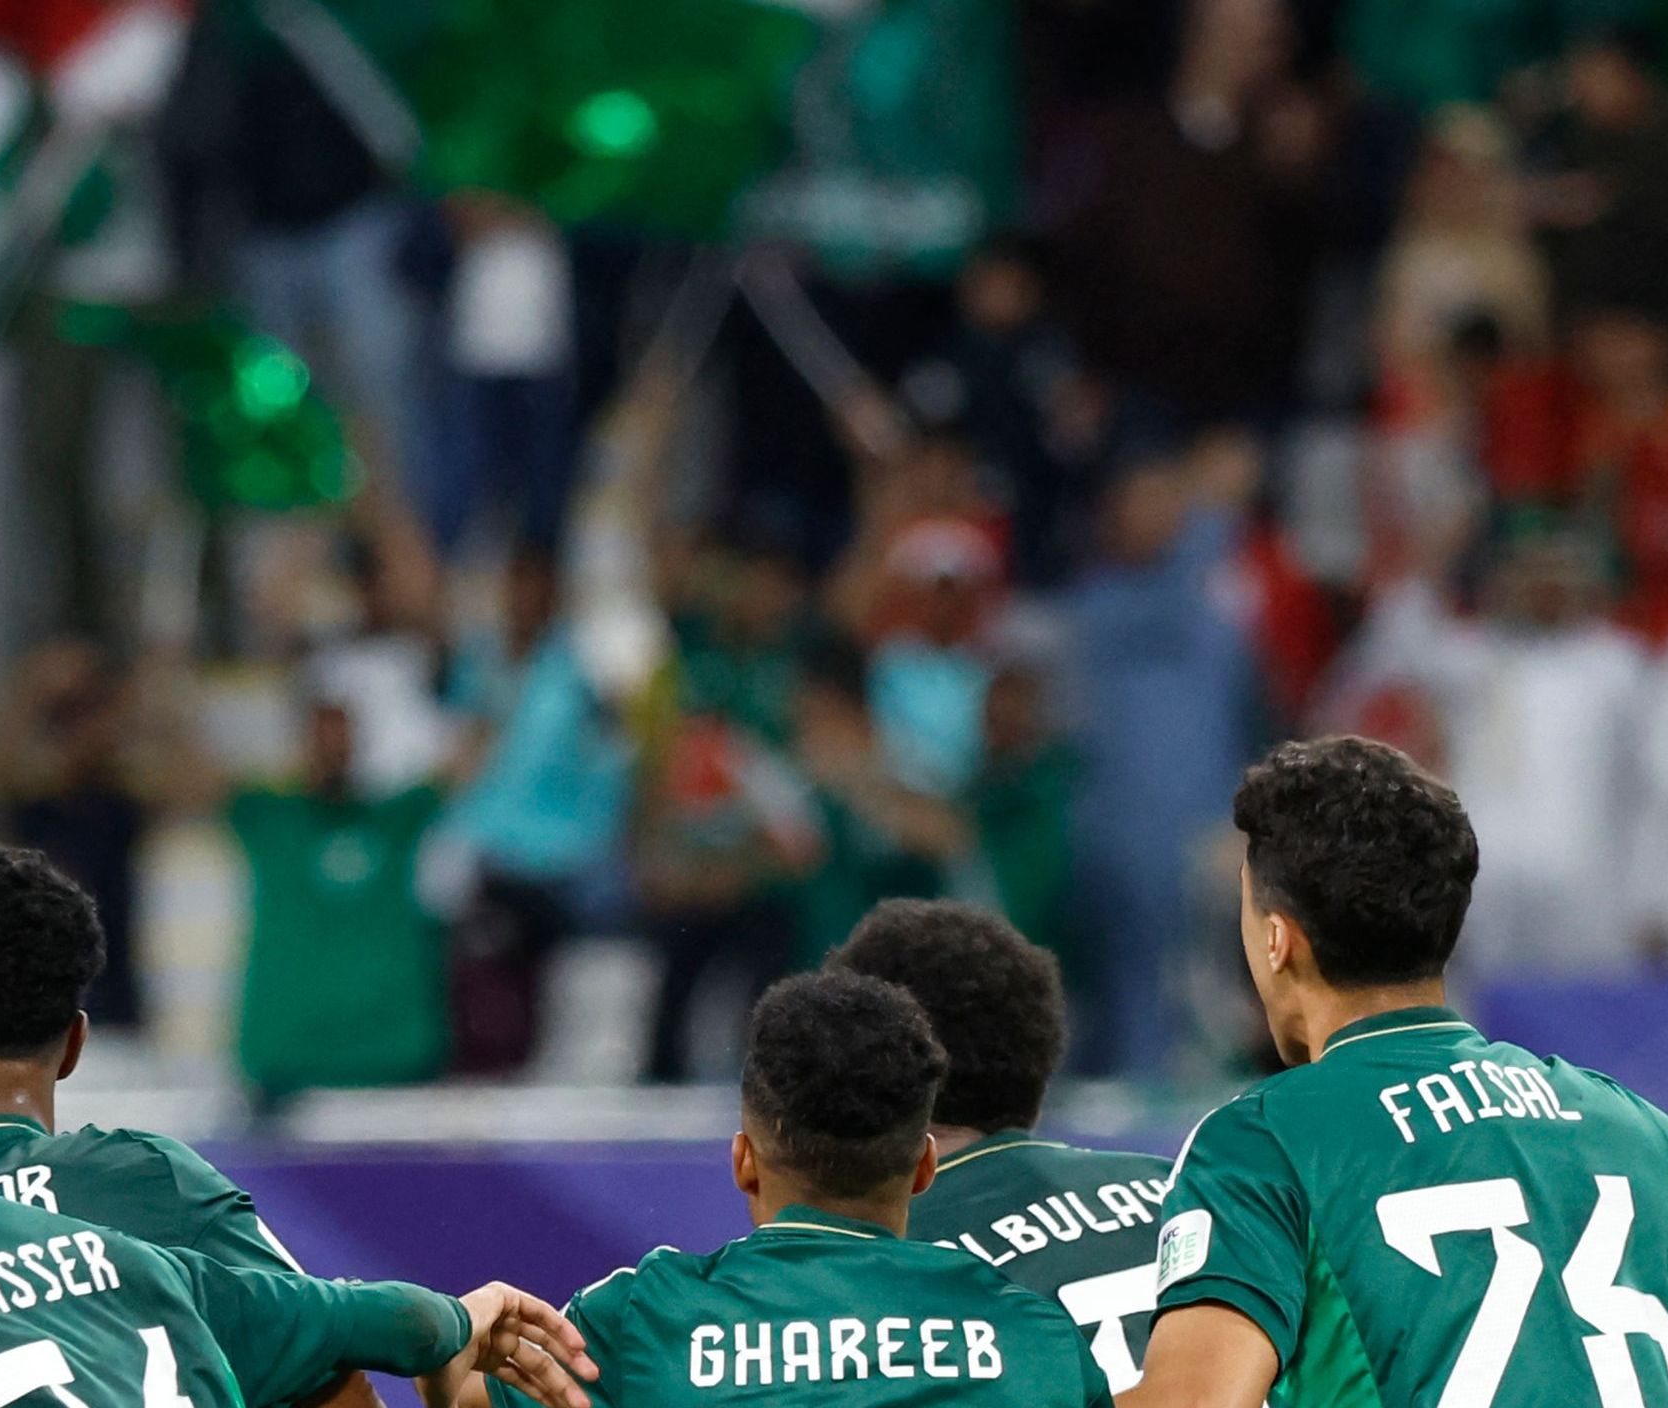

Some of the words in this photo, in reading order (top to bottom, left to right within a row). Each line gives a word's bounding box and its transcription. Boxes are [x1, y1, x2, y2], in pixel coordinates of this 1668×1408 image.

[1379, 1059, 1583, 1143] FAISAL
[932, 1178, 1172, 1267] LBULAY
[690, 1317, 1003, 1387] GHAREEB
